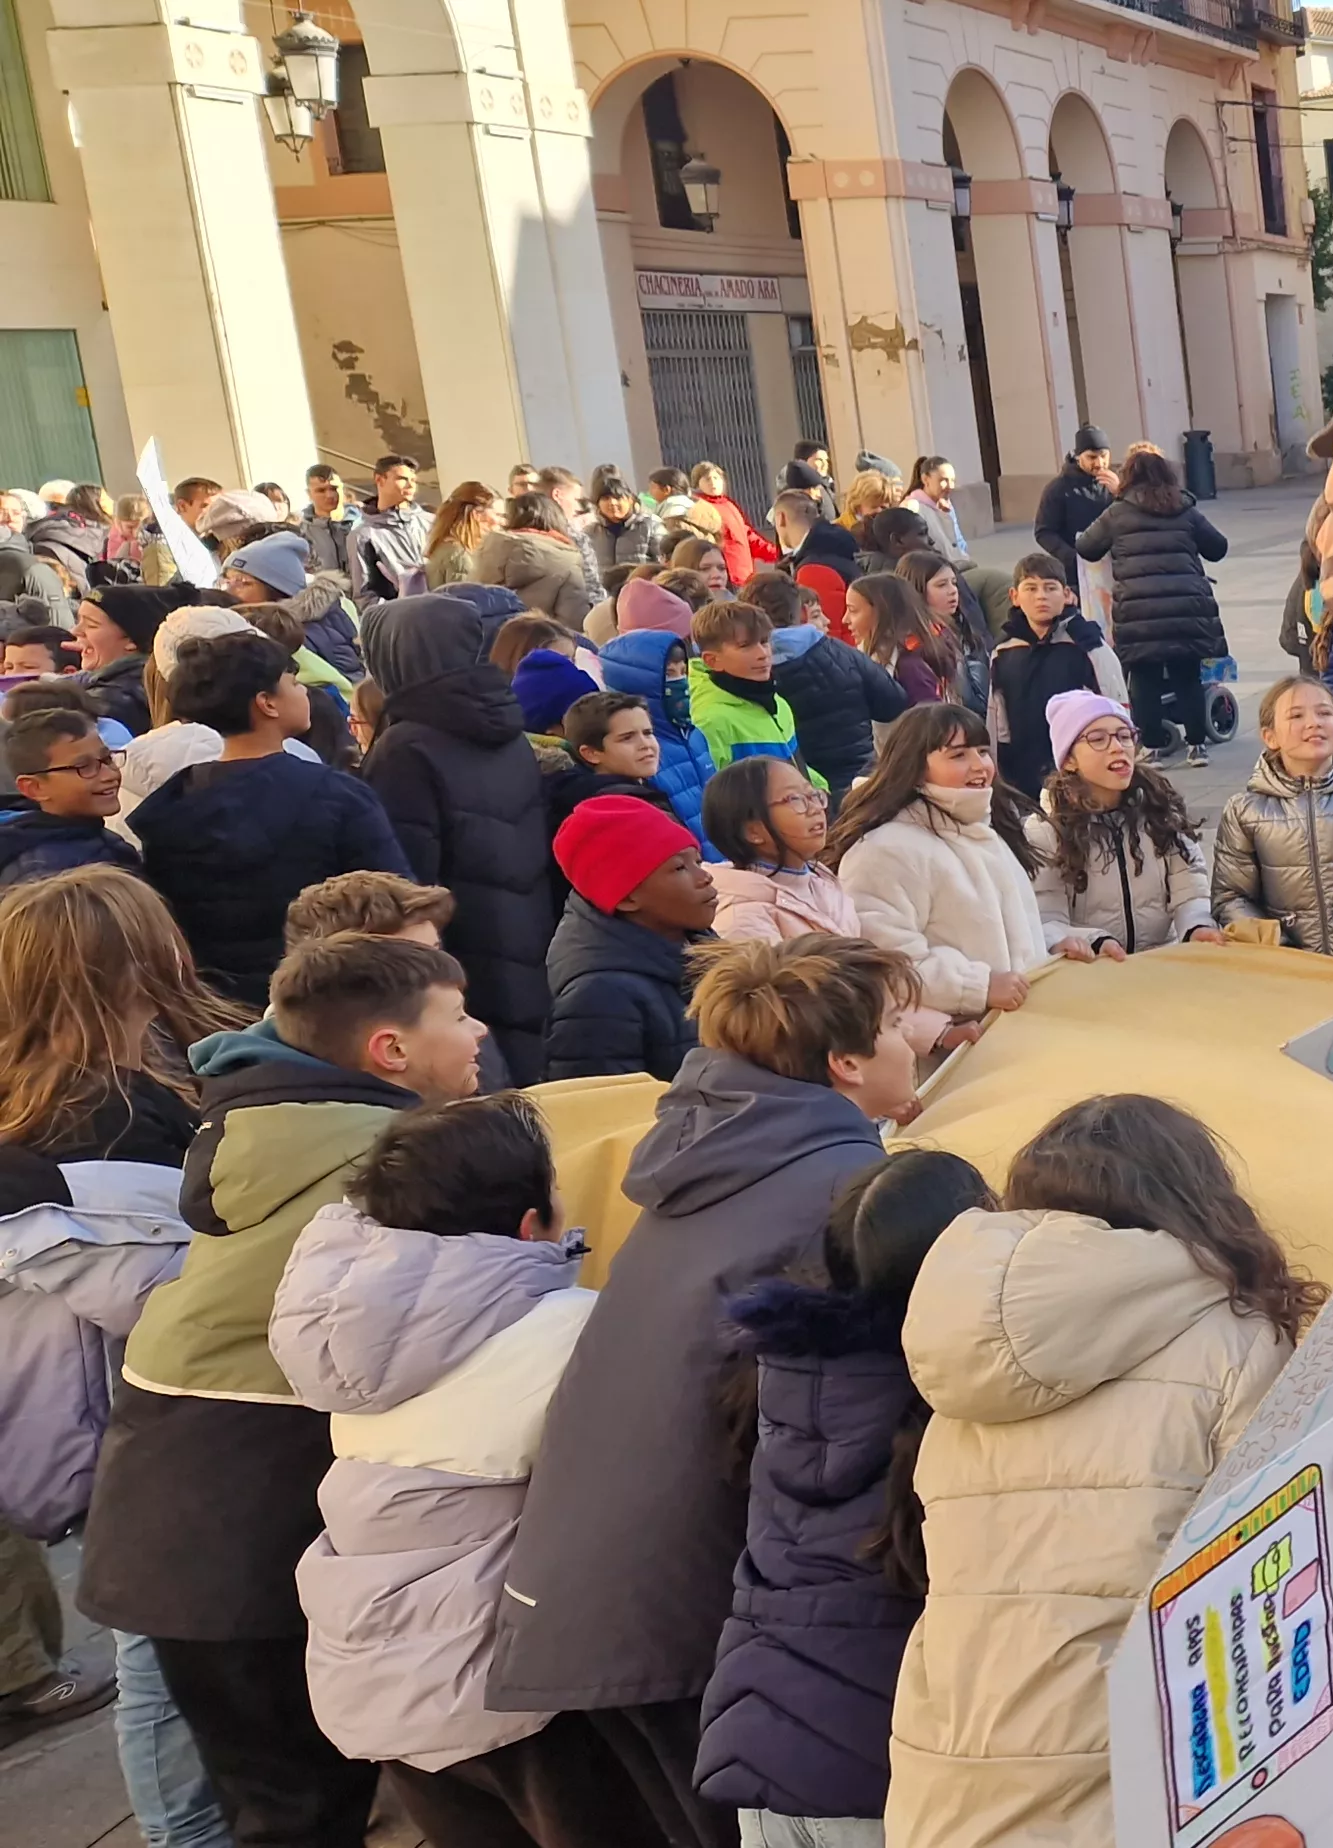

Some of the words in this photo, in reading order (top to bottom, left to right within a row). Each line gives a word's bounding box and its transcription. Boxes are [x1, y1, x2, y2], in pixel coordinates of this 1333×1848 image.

[638, 273, 702, 297] CHACINERIA
[720, 278, 754, 299] AMADO
[757, 279, 778, 300] ARA
[1292, 1618, 1313, 1706] EDAD
